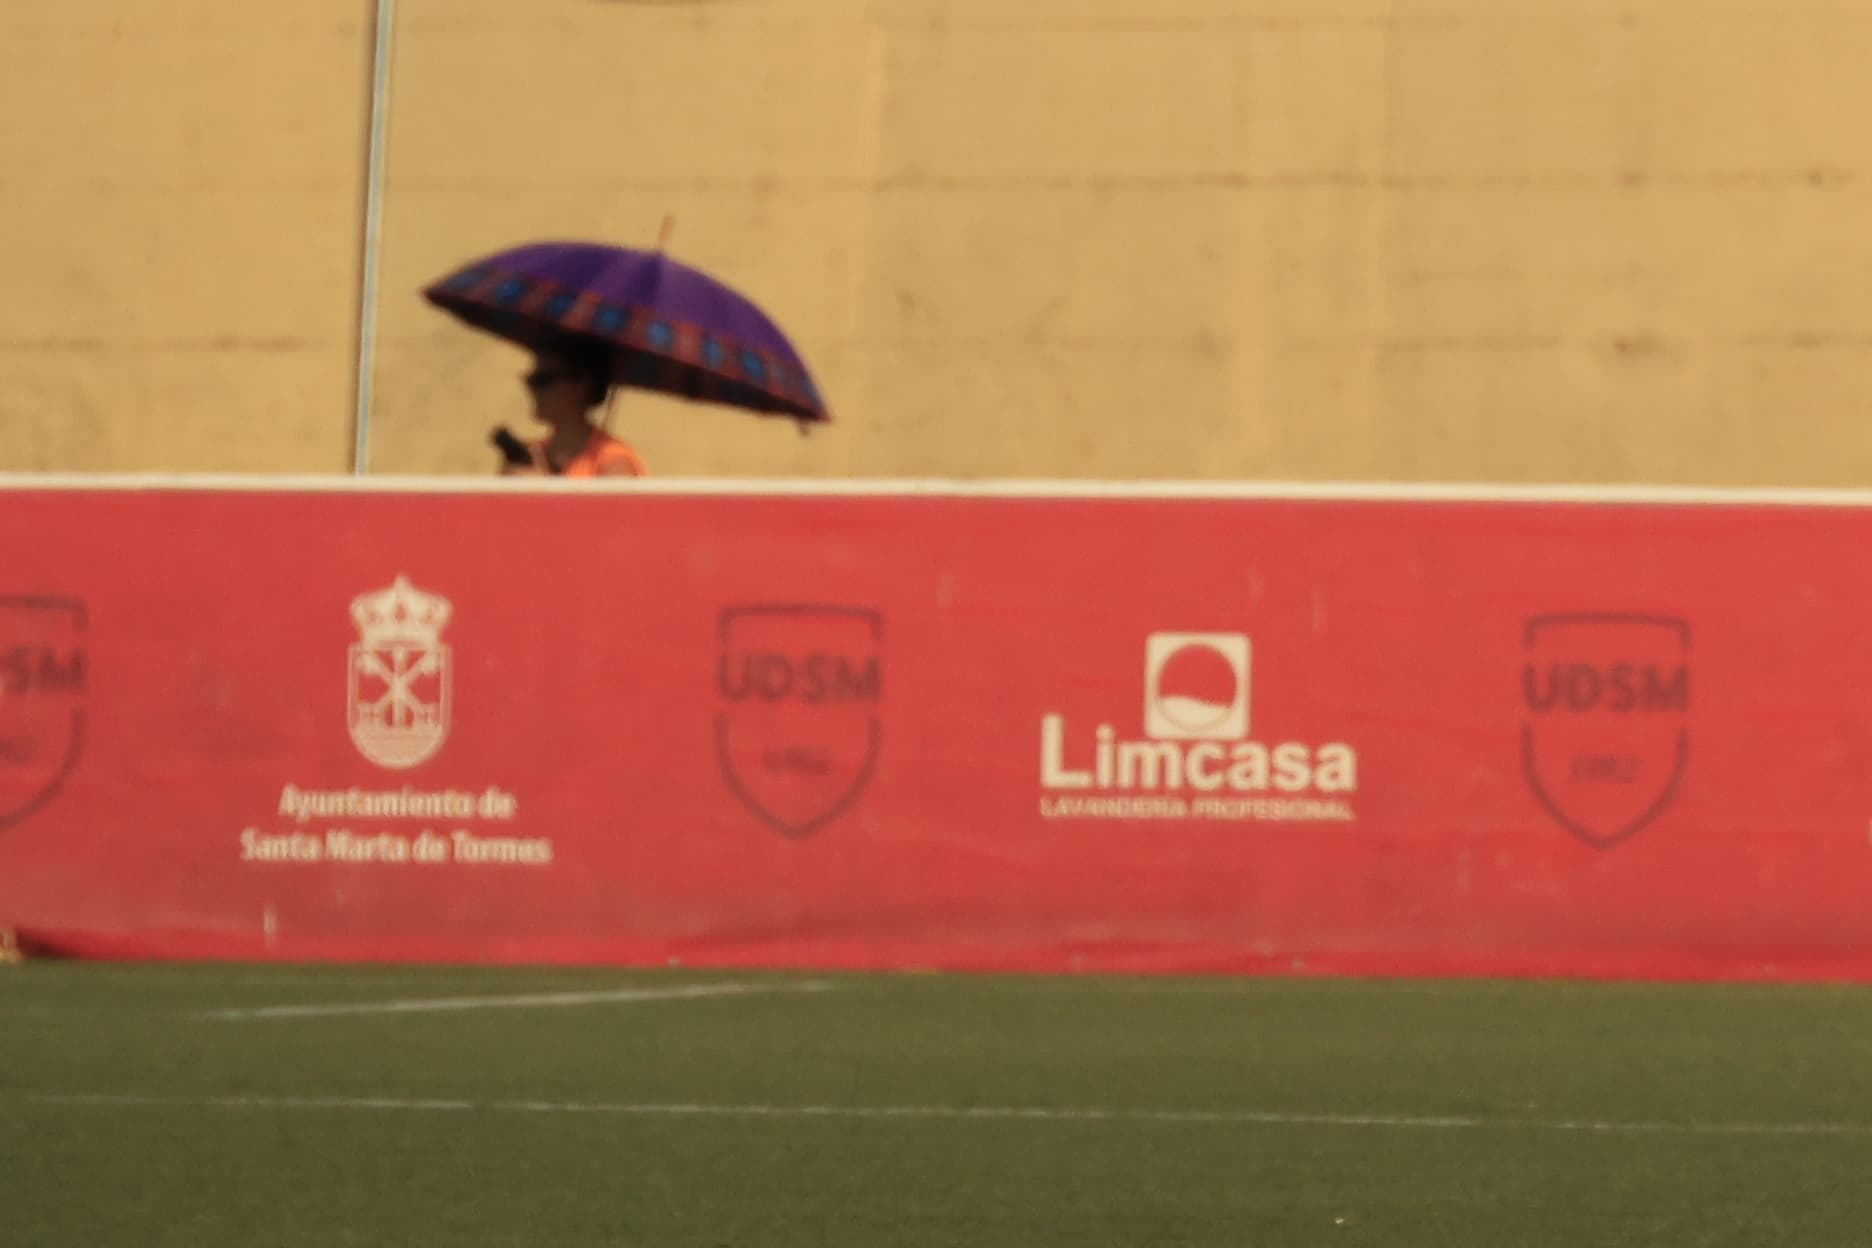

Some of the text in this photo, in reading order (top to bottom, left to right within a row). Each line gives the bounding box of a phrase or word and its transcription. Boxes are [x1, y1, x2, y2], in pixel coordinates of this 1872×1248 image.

[2, 646, 85, 692] SM
[718, 651, 881, 702] UDSM
[1523, 661, 1689, 713] UDSM
[1041, 713, 1356, 791] Limcasa
[278, 784, 517, 821] Ayuntamiento de
[239, 827, 554, 864] Santa Marta de Tormes
